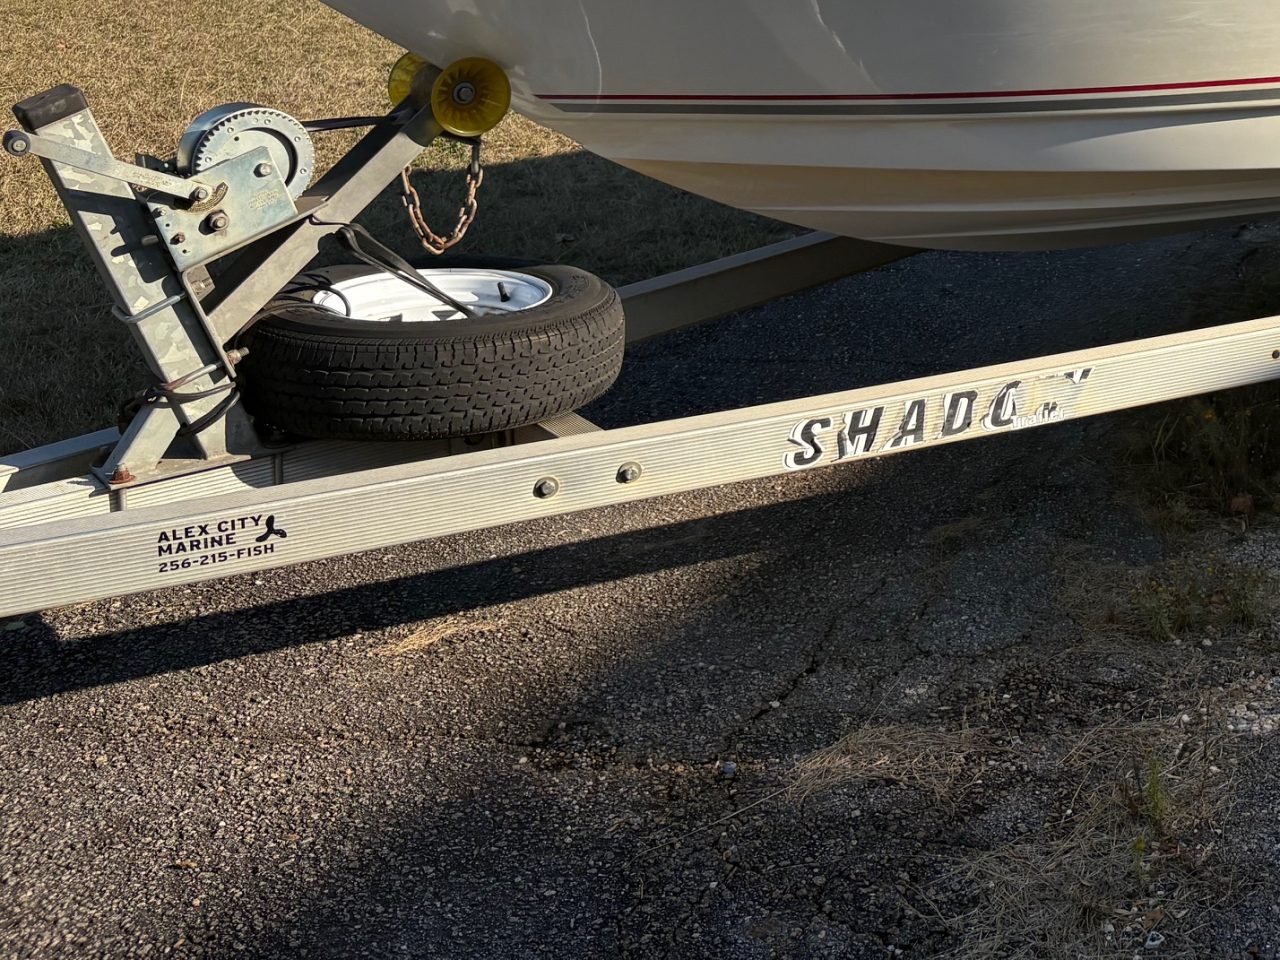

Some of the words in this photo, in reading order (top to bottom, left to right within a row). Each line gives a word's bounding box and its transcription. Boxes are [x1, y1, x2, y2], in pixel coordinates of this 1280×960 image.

[157, 524, 210, 544] ALEX
[217, 515, 263, 533] CITY
[158, 533, 237, 557] MARINE
[158, 543, 275, 573] 256-215-FISH
